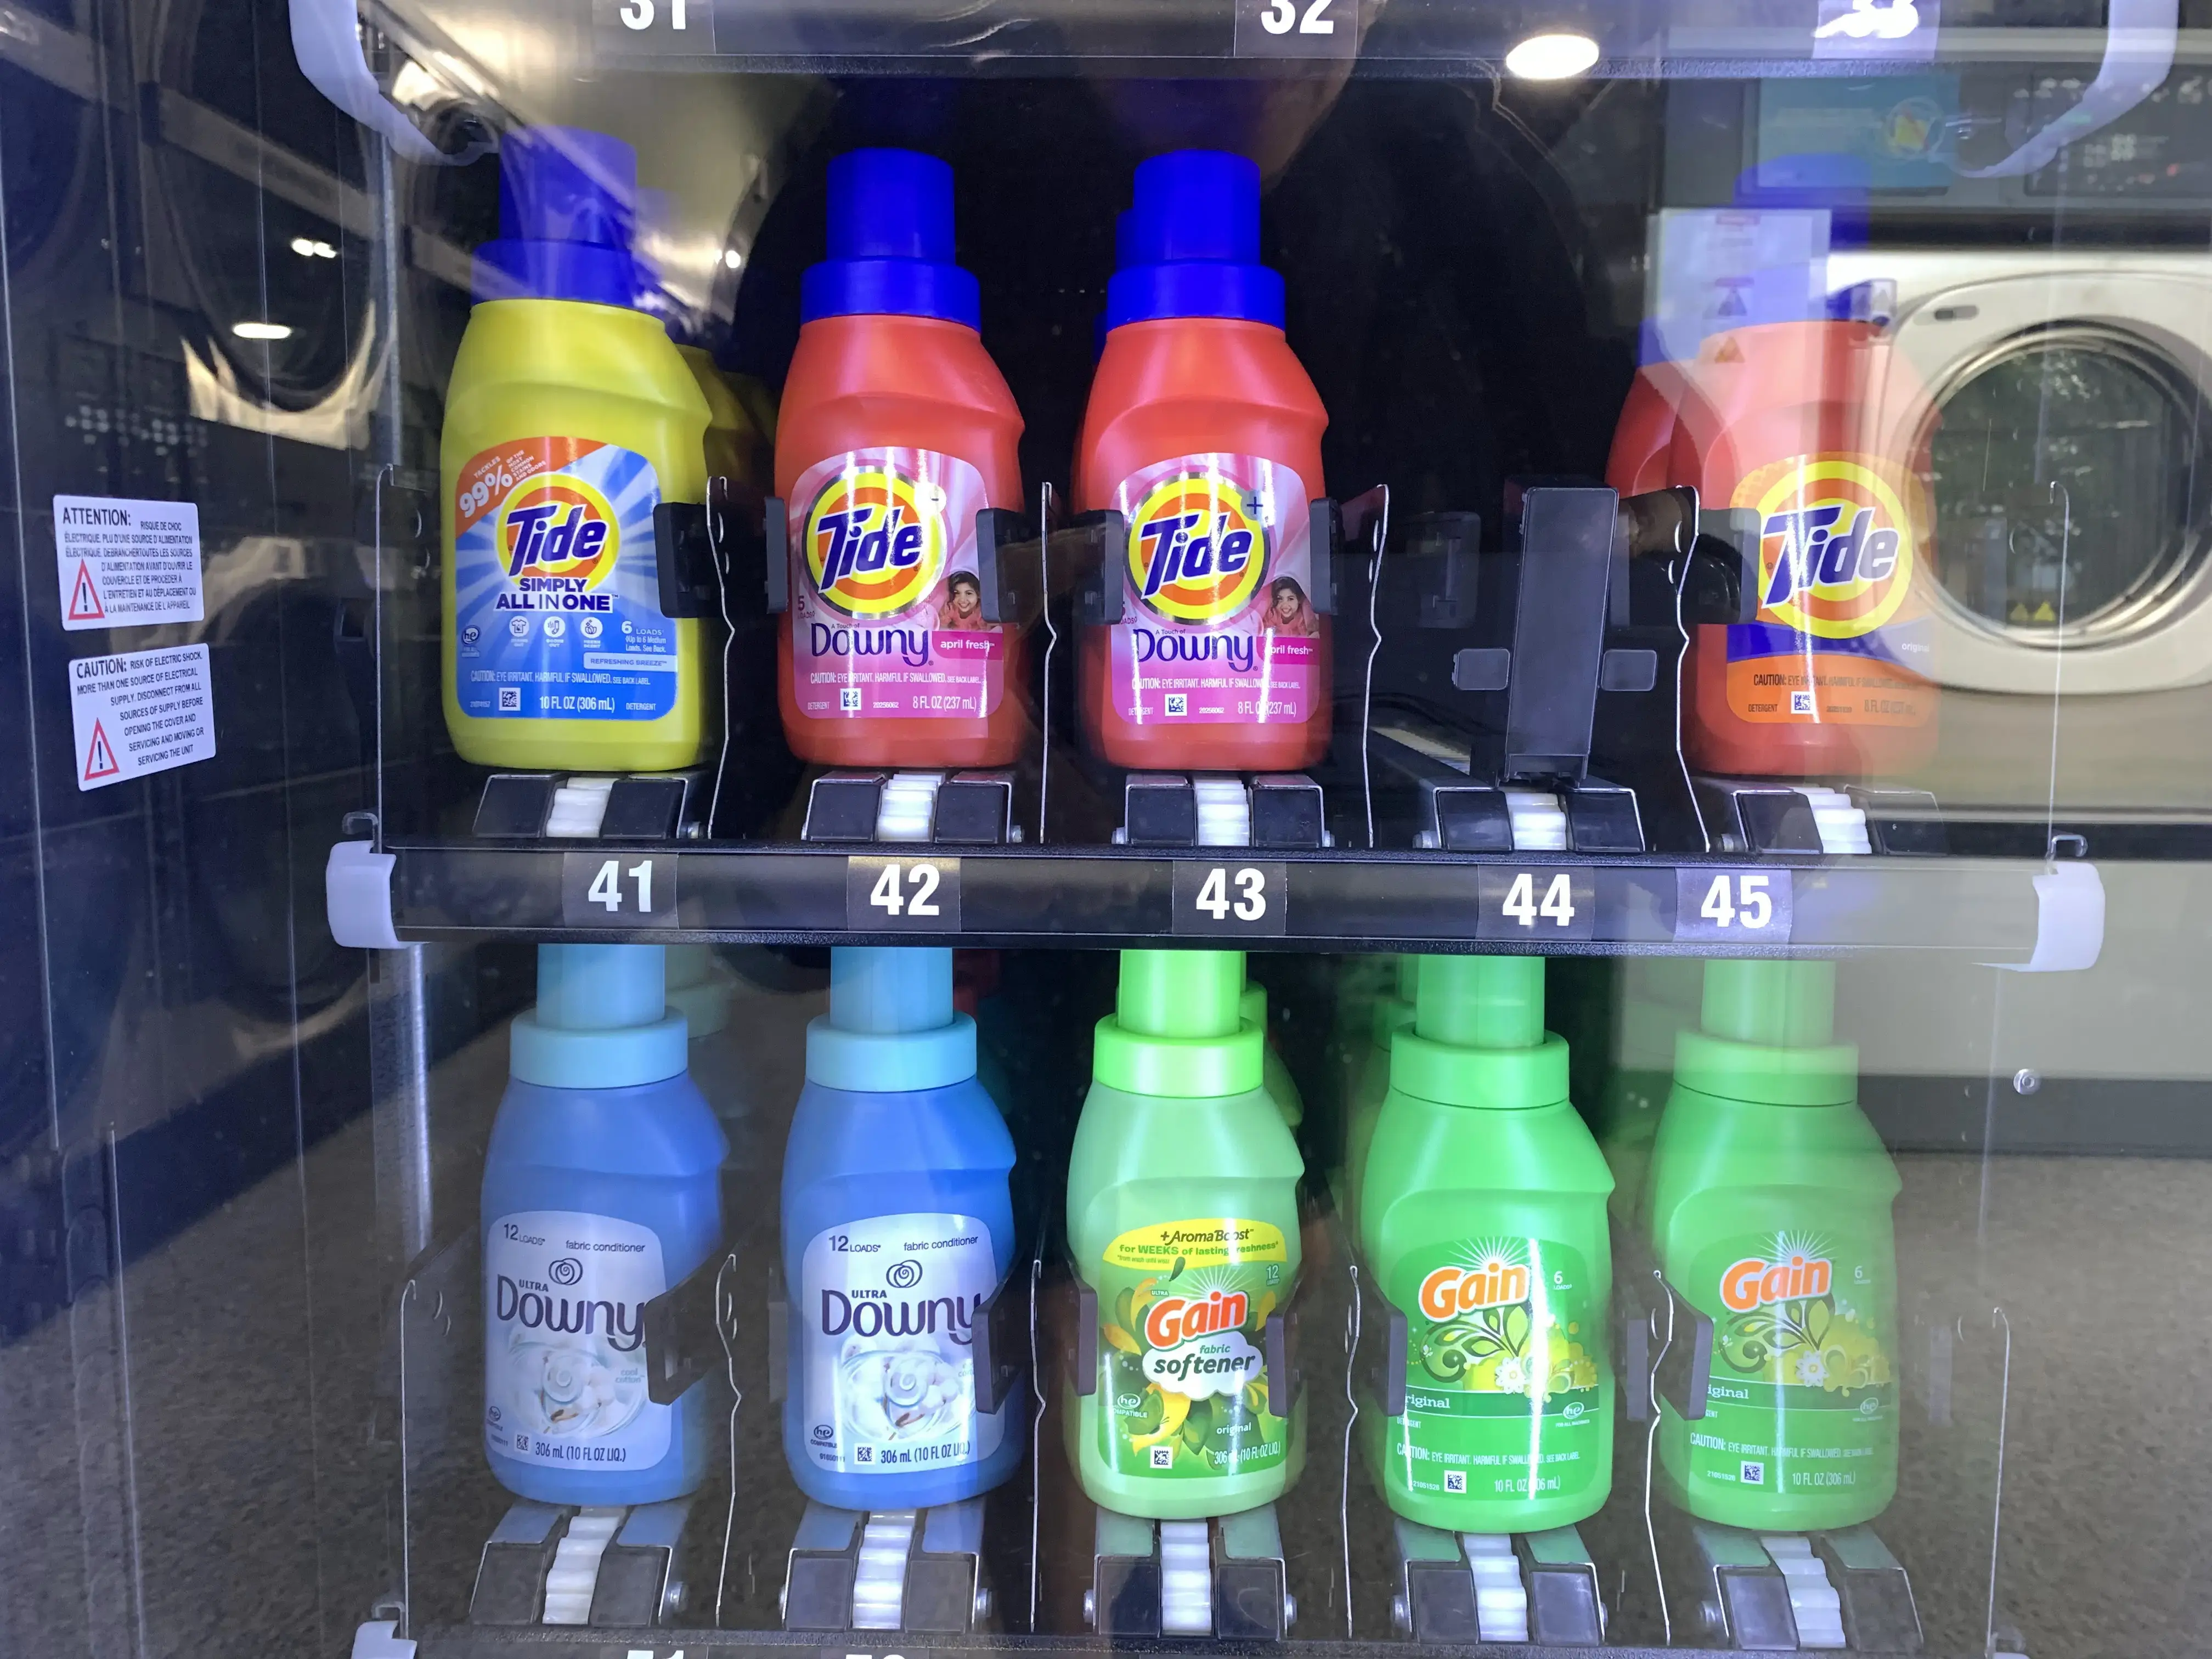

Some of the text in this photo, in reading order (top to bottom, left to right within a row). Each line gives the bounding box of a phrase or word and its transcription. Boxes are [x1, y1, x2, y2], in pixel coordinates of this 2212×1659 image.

[473, 456, 500, 478] TACKLES
[511, 455, 534, 472] COMMON
[527, 460, 546, 473] ODORS
[460, 464, 513, 517] 99%
[63, 507, 182, 531] ATTENTION: CHOC
[132, 535, 153, 543] SOURCE
[506, 504, 610, 577] Tide
[817, 506, 922, 594] Tide
[1139, 512, 1251, 599] Tide
[1761, 503, 1900, 609] Tide
[103, 576, 134, 585] COUVERCLE
[519, 578, 588, 592] SIMPLY
[118, 603, 154, 612] MAINTENANCE
[496, 594, 534, 609] ALL
[539, 594, 559, 610] IN
[798, 596, 805, 611] 5
[622, 621, 633, 634] 6
[811, 623, 928, 667] Downy
[940, 640, 963, 650] april
[1133, 629, 1252, 672] Downy
[77, 651, 202, 679] CAUTION: RISK ELECTRIC SHOCK.
[77, 668, 198, 695] MORE THAN ONE SOURCE OF ELECTRICAL
[535, 672, 612, 684] HARMFUL SWALLOWED.
[811, 672, 947, 684] CAUTION: EYE HARMFUL SWALLOWED.
[1162, 679, 1228, 689] EYE IRRITANT. HARMFUL
[1754, 674, 1799, 686] CAUTION: EYE
[111, 682, 201, 706] SUPPLY. DISCONNECT FROM ALL
[120, 697, 203, 720] SOURCES OF SUPPLY BEFORE
[539, 696, 615, 713] 10 FL OZ (306 mL)
[808, 702, 830, 710] DETERGENT
[913, 696, 977, 711] 8 FL OZ (237 mL)
[1238, 702, 1296, 716] 8 FL mL)
[124, 713, 195, 736] OPENING THE COVER AND
[129, 727, 204, 752] SERVICING AND MOVING OR
[138, 744, 193, 766] SERVICING THE UNIT
[588, 860, 653, 913] 41
[870, 864, 940, 916] 42
[1196, 867, 1266, 921] 43
[1502, 872, 1575, 927] 44
[1700, 874, 1773, 928] 45
[504, 1223, 518, 1240] 12
[566, 1240, 645, 1252] fabric conditioner
[828, 1235, 849, 1251] 12
[904, 1235, 978, 1251] fabric conditioner
[1138, 1245, 1179, 1254] WEEKS
[1196, 1247, 1229, 1255] lasting
[1266, 1265, 1279, 1279] 12
[1554, 1271, 1562, 1284] 6
[1855, 1266, 1862, 1278] 6
[518, 1279, 549, 1292] ULTRA
[1419, 1262, 1530, 1321] Gain
[1720, 1256, 1831, 1312] Gain
[851, 1289, 887, 1299] ULTRA
[496, 1274, 645, 1352] Downy
[821, 1289, 980, 1345] Downy
[1146, 1291, 1246, 1347] Gain
[1200, 1345, 1230, 1353] fabric
[1153, 1354, 1255, 1381] softener
[1708, 1386, 1749, 1399] iginal
[1406, 1395, 1450, 1409] riginal
[1217, 1423, 1251, 1436] original
[535, 1442, 625, 1463] 306 mL (10 FL OZ LIQ.)
[1690, 1432, 1799, 1458] CAUTION: EYE HARMFUL
[881, 1444, 951, 1464] 306 mL (10 FL OZ
[1214, 1451, 1227, 1464] 306
[1252, 1448, 1259, 1462] FL
[1260, 1447, 1268, 1460] OZ
[1432, 1452, 1500, 1465] EYE IRRITANT. HARMFUL
[1494, 1480, 1526, 1493] 10 FL OZ
[1792, 1472, 1842, 1486] 10 FL OZ (306
